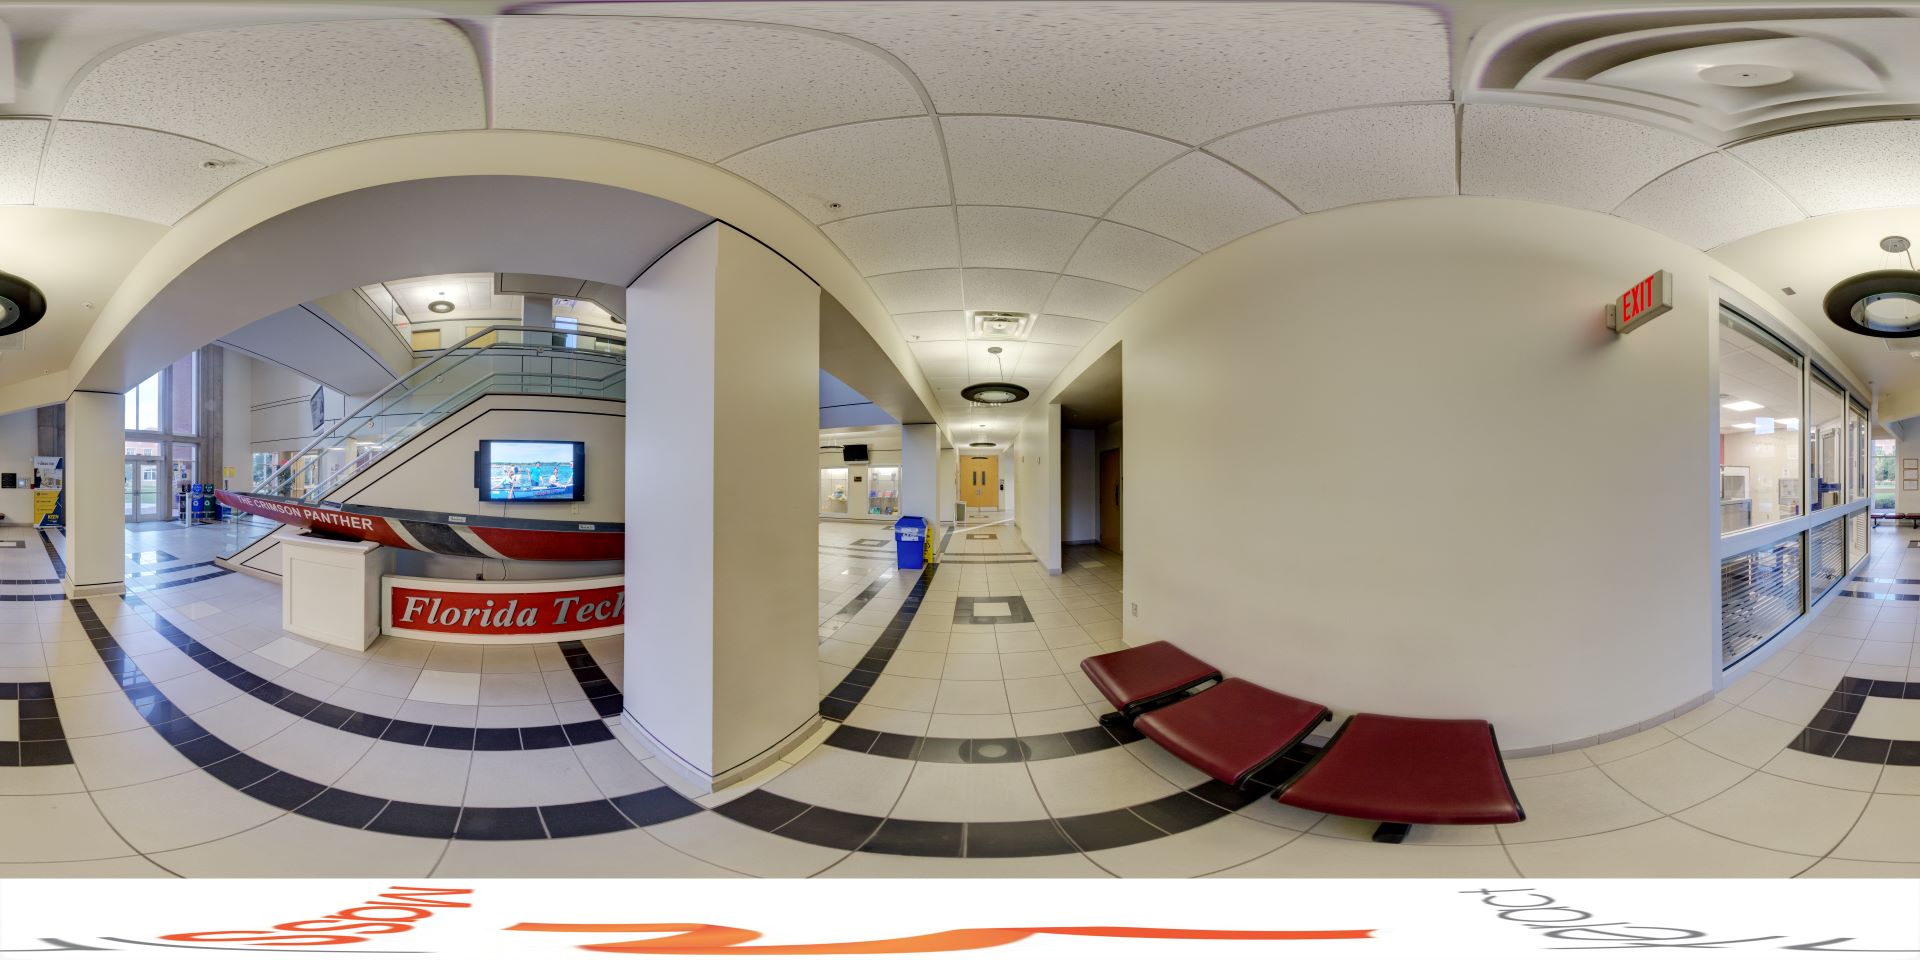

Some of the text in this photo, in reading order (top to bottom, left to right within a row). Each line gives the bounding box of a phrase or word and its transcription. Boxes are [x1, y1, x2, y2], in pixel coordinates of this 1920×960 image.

[1623, 274, 1654, 322] EXIT
[238, 495, 374, 531] THE CRIMSON PANTHER
[401, 596, 537, 627] Florida
